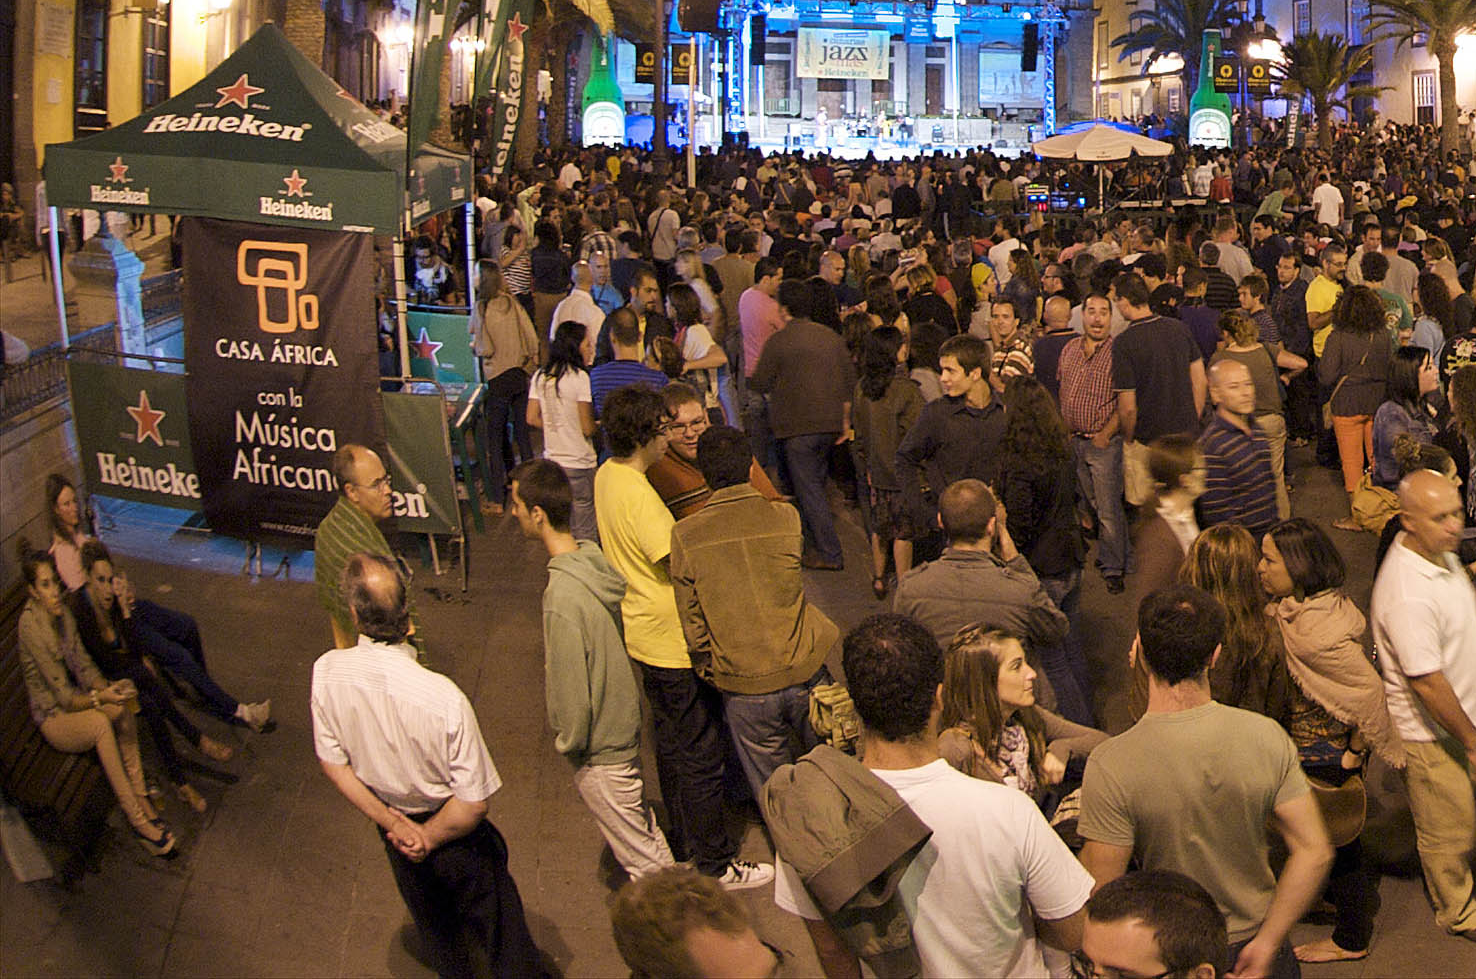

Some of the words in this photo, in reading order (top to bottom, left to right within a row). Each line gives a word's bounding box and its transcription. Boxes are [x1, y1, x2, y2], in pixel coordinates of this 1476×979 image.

[819, 38, 868, 65] jazz
[143, 113, 305, 142] Heineken
[90, 185, 150, 205] Heineken
[259, 197, 333, 222] Heineken
[215, 338, 265, 361] CASA
[270, 338, 339, 367] ÁFRICA
[257, 392, 285, 407] con
[289, 387, 303, 408] la
[235, 410, 337, 452] Música
[97, 452, 201, 498] Heineke
[232, 448, 339, 493] African
